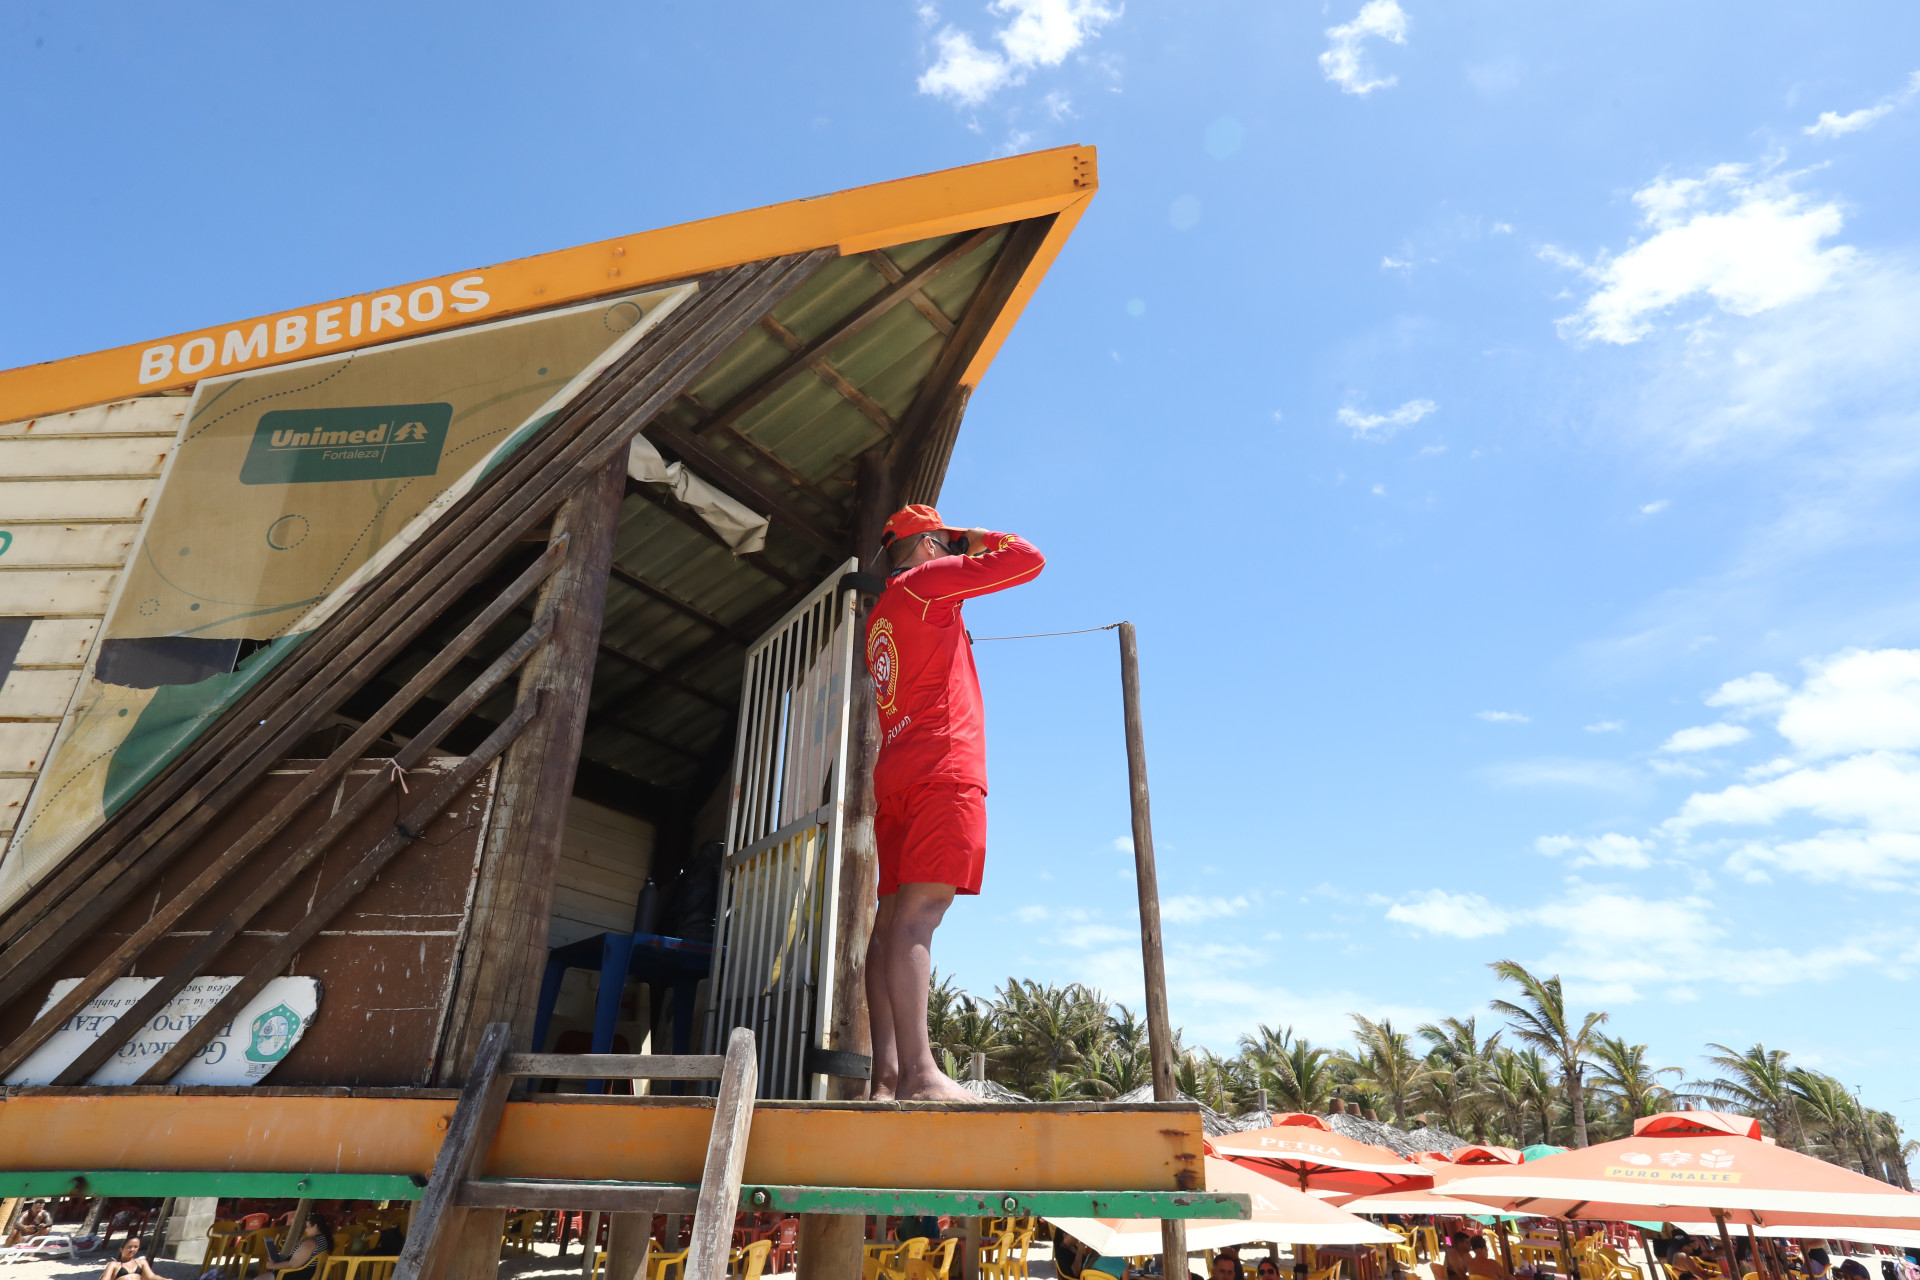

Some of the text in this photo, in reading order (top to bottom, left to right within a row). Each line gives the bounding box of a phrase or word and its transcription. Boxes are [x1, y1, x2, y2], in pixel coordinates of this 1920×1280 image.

[138, 276, 490, 384] BOMBEIROS
[270, 423, 388, 447] Unimed
[322, 449, 380, 461] Fortaleza
[1260, 1137, 1343, 1156] PETRA
[1612, 1169, 1732, 1182] PURO MALTE
